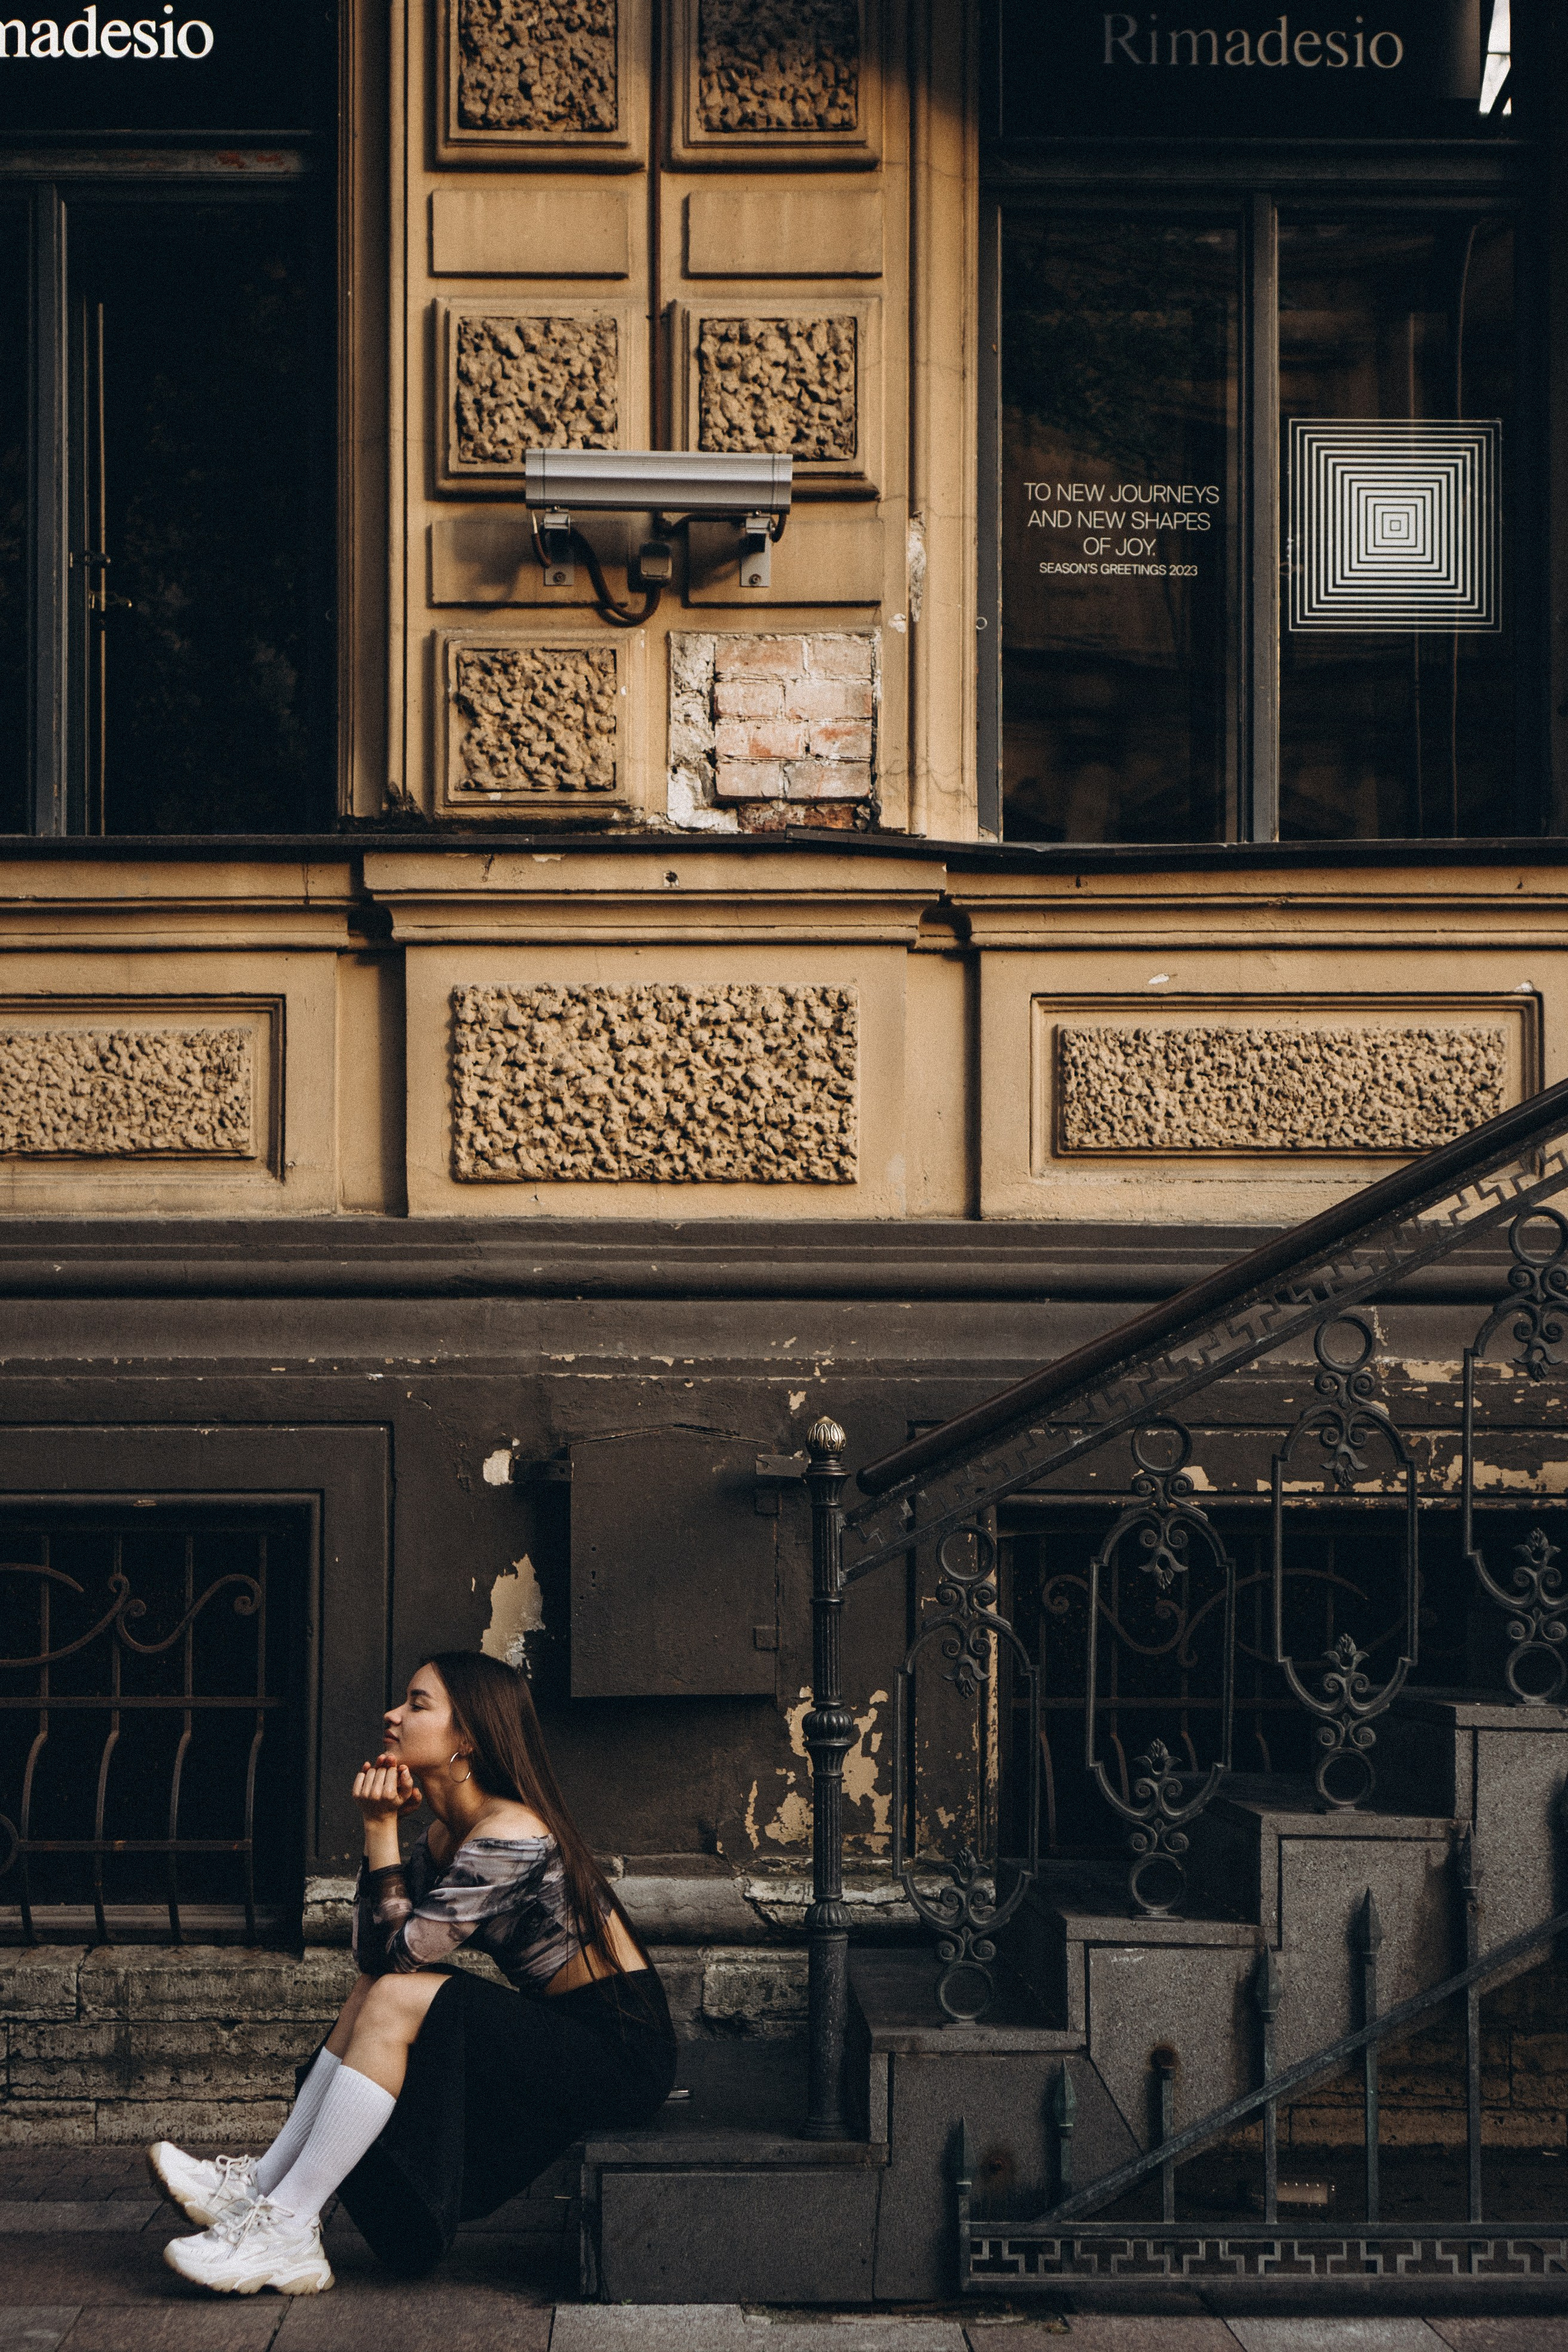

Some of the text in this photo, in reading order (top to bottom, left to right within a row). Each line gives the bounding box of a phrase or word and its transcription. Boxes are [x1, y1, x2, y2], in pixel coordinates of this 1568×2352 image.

[1102, 13, 1404, 69] Rimadesio
[1023, 481, 1220, 504] TO NEW JOURNEYS
[1027, 509, 1212, 531] AND NEW SHAPES
[1082, 536, 1157, 557] OF JOY.
[1039, 562, 1199, 577] SEASON'S GREETINGS 2023
